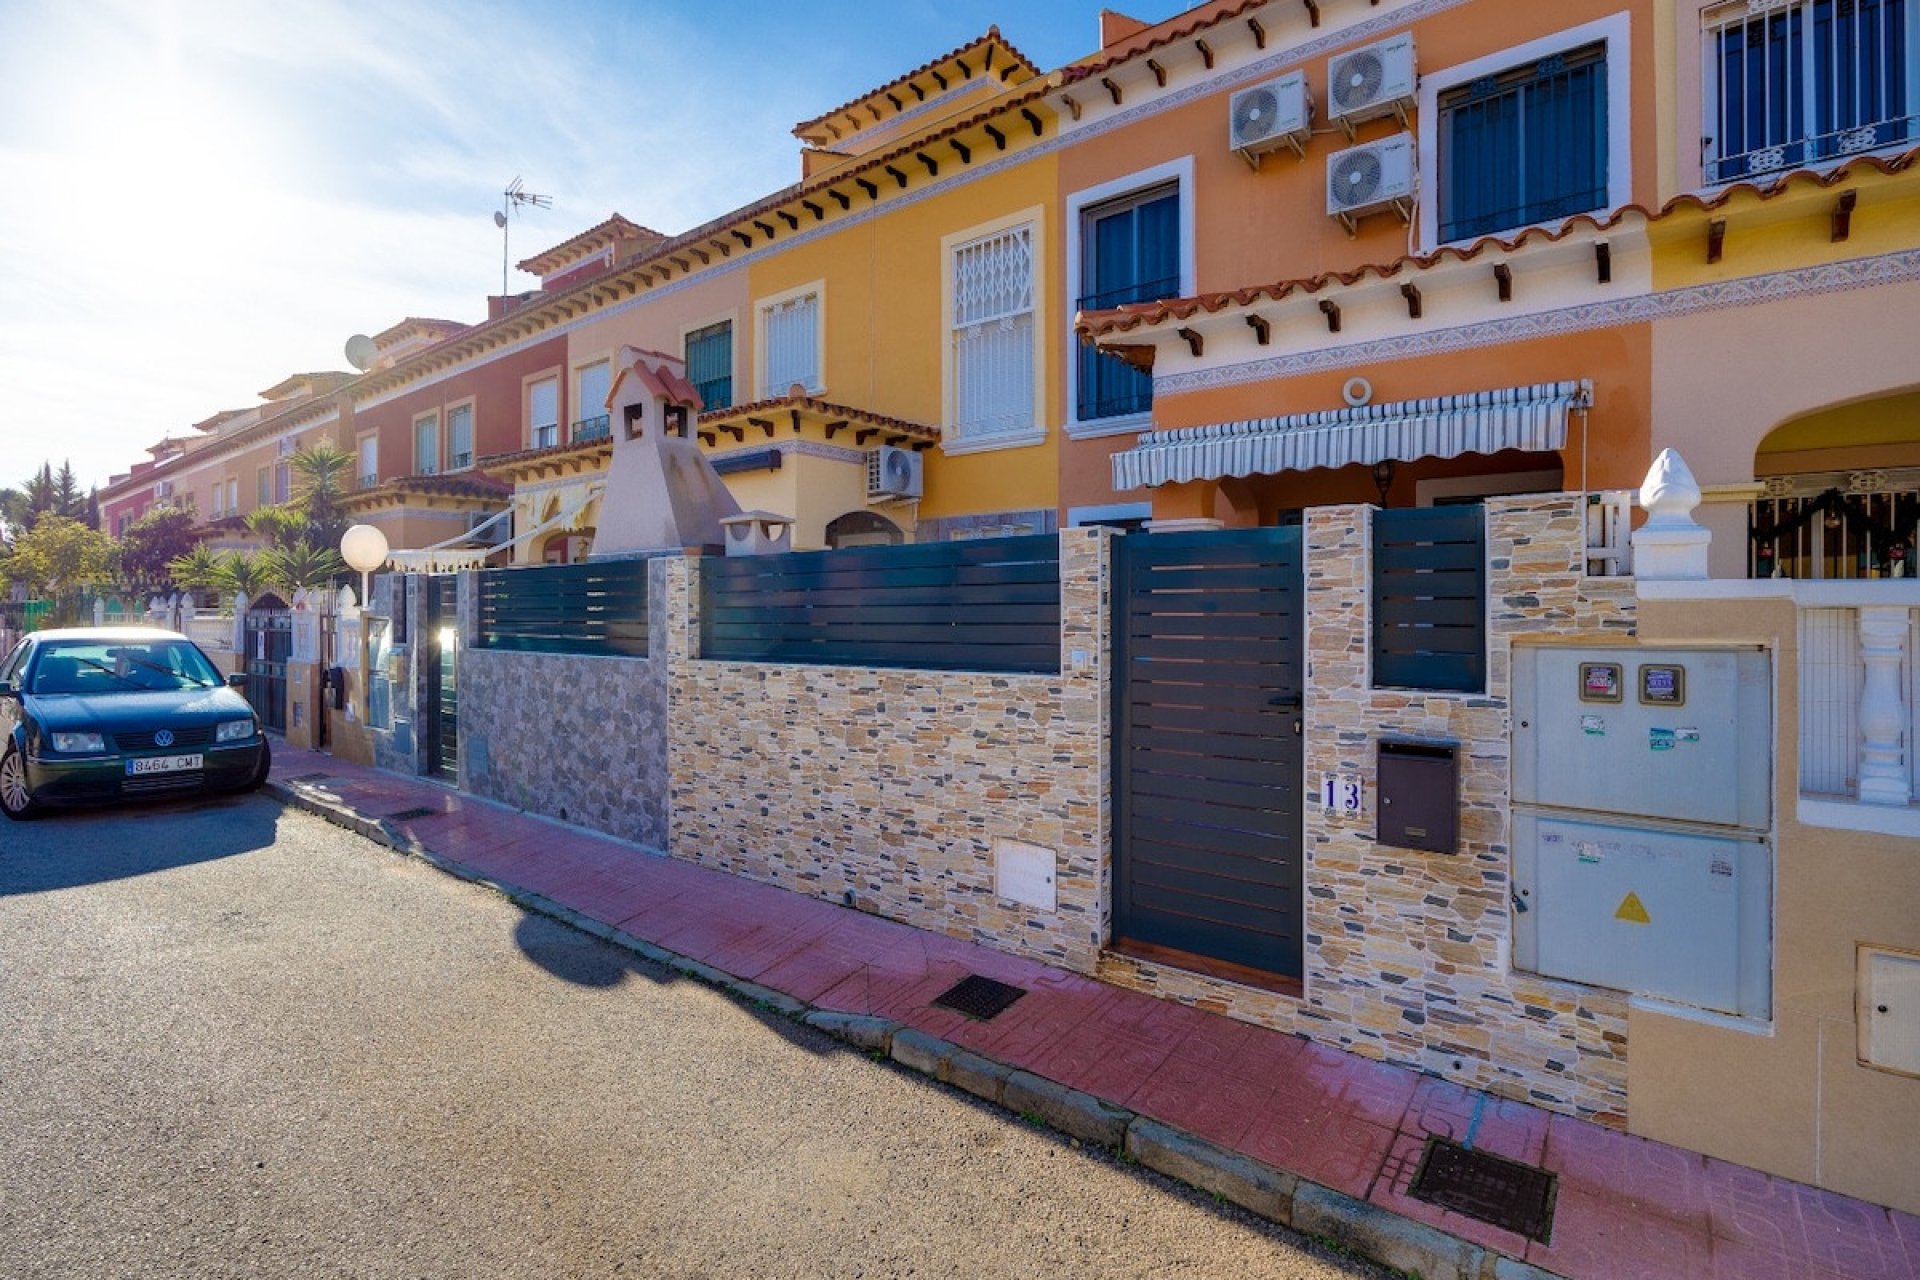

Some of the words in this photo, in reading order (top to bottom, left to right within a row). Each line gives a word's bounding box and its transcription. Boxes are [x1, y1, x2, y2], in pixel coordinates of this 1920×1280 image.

[136, 759, 169, 772] 8464
[177, 756, 201, 769] CMT
[1326, 780, 1359, 809] 13
